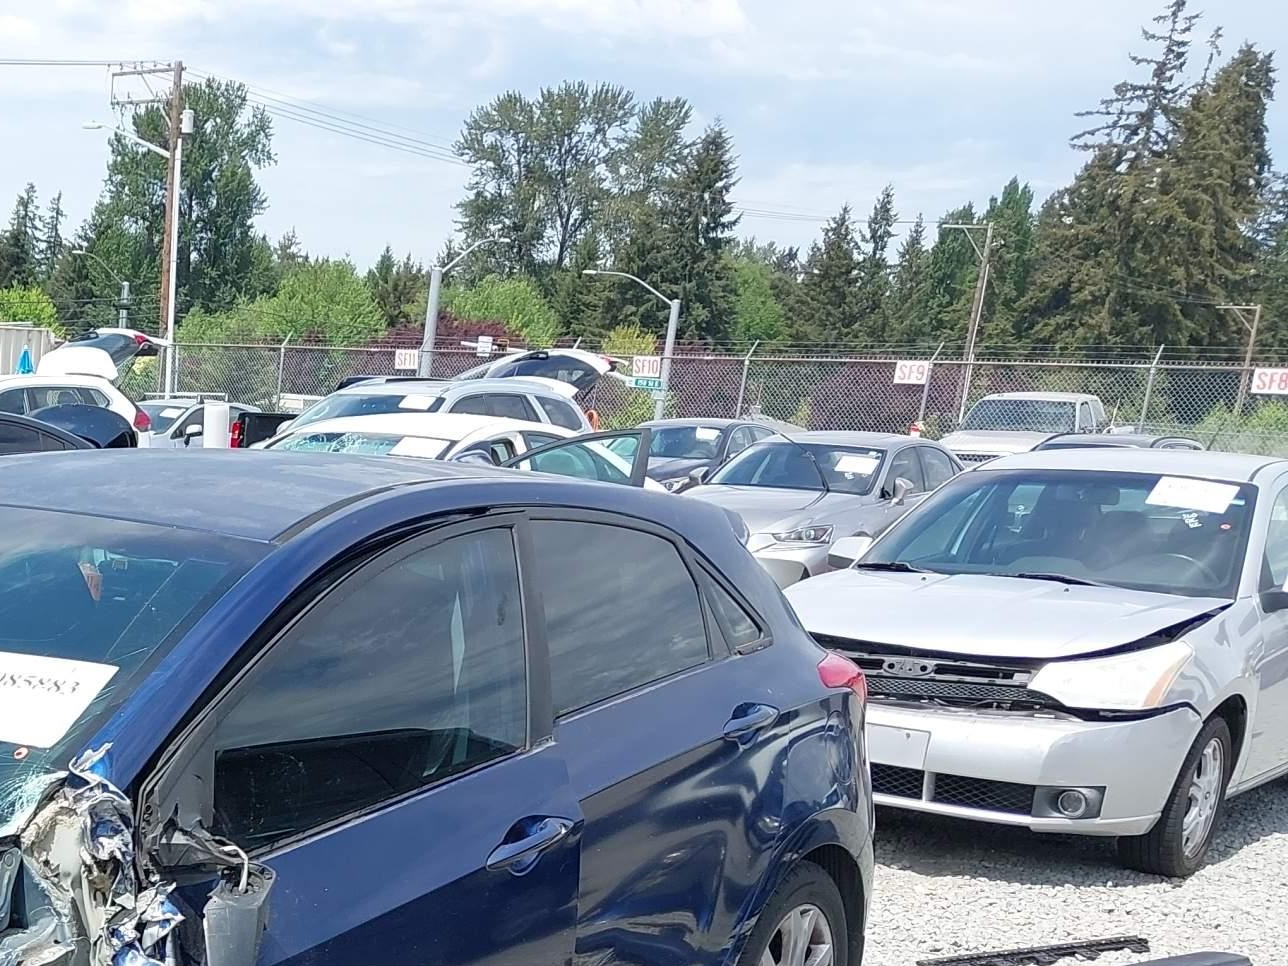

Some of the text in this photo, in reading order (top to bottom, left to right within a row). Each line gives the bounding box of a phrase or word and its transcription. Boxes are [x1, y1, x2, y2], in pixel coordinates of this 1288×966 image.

[397, 352, 416, 367] SF11
[634, 359, 659, 374] SF10
[898, 364, 926, 380] SF9
[1256, 371, 1288, 390] SF8
